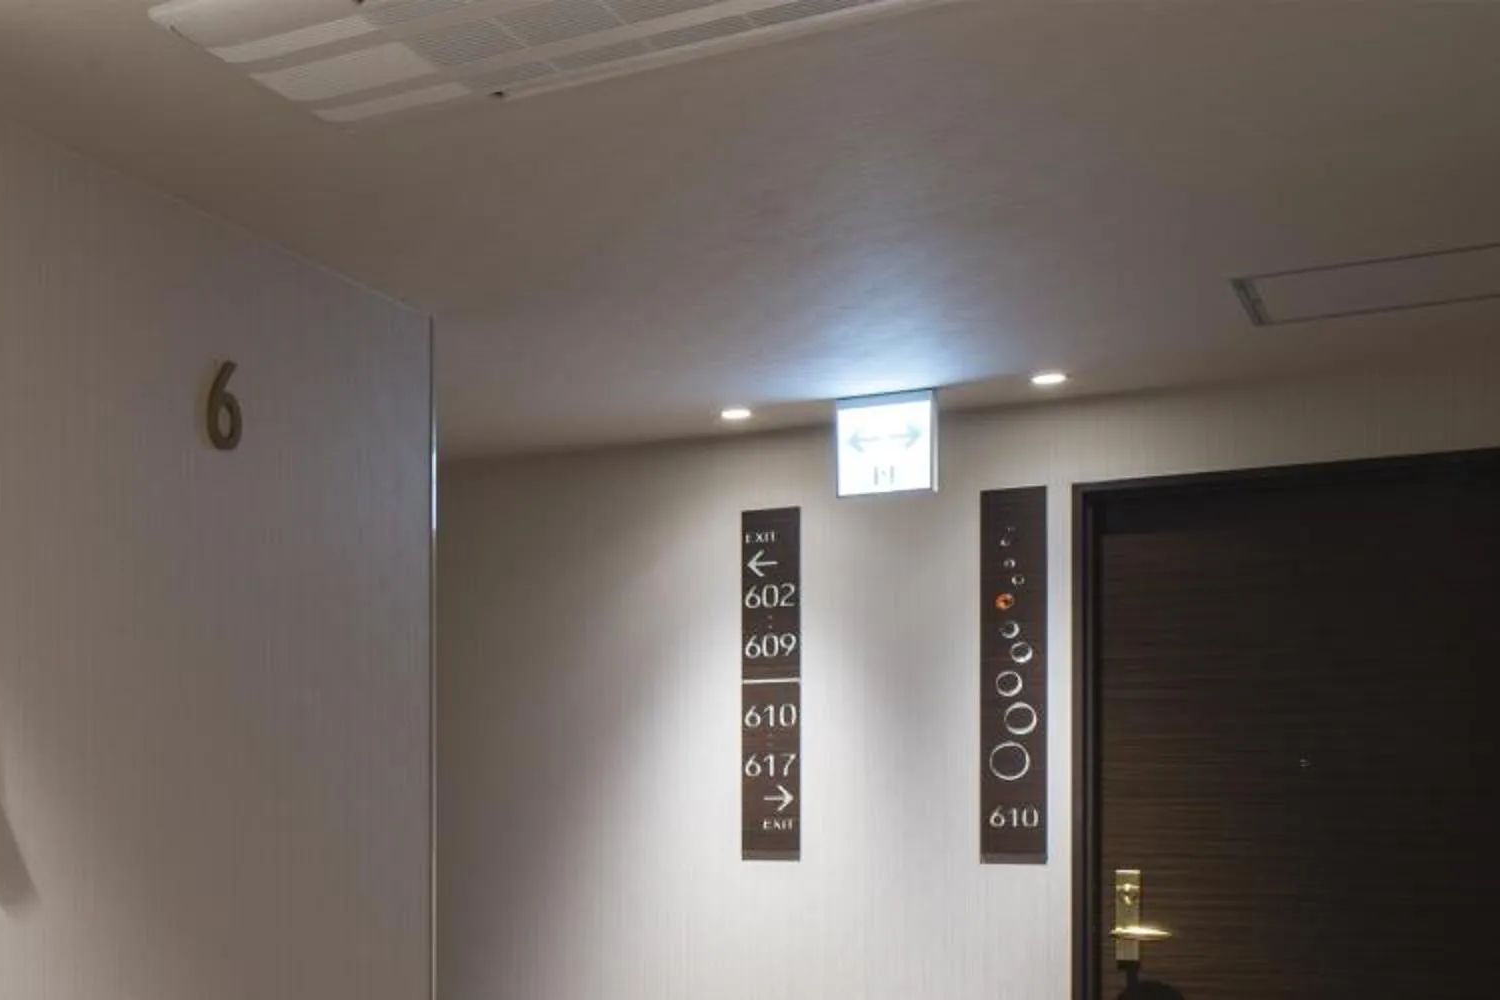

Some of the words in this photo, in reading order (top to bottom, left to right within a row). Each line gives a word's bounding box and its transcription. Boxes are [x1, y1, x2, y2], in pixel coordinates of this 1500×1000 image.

[206, 359, 243, 452] 6
[745, 531, 777, 544] EXIT
[745, 583, 796, 608] 602
[745, 633, 797, 658] 609
[744, 704, 797, 727] 610
[745, 753, 797, 777] 617
[763, 817, 793, 831] EXIT
[989, 805, 1039, 828] 610
